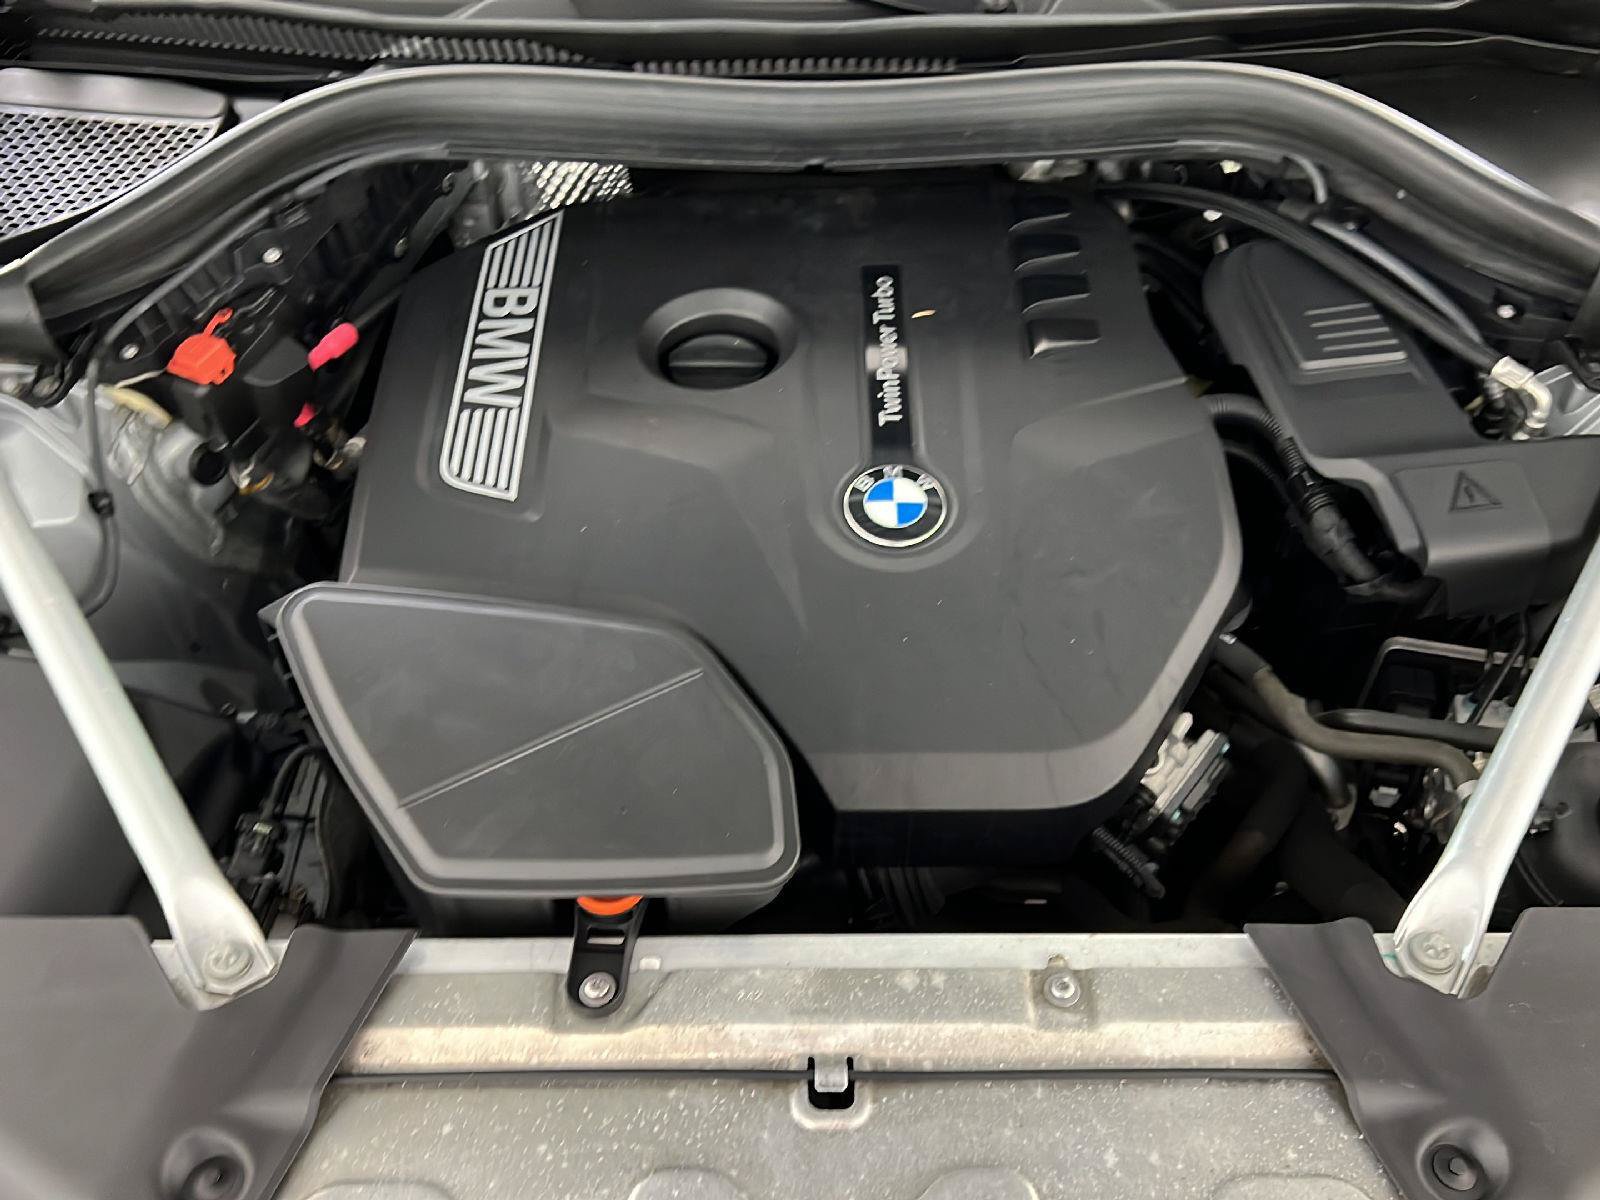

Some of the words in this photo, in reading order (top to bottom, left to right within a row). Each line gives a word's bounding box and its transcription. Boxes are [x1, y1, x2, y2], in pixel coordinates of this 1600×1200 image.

[870, 275, 896, 324] Turbo
[463, 287, 541, 409] BMW
[876, 324, 903, 427] TwinPower
[853, 465, 935, 492] BMW
